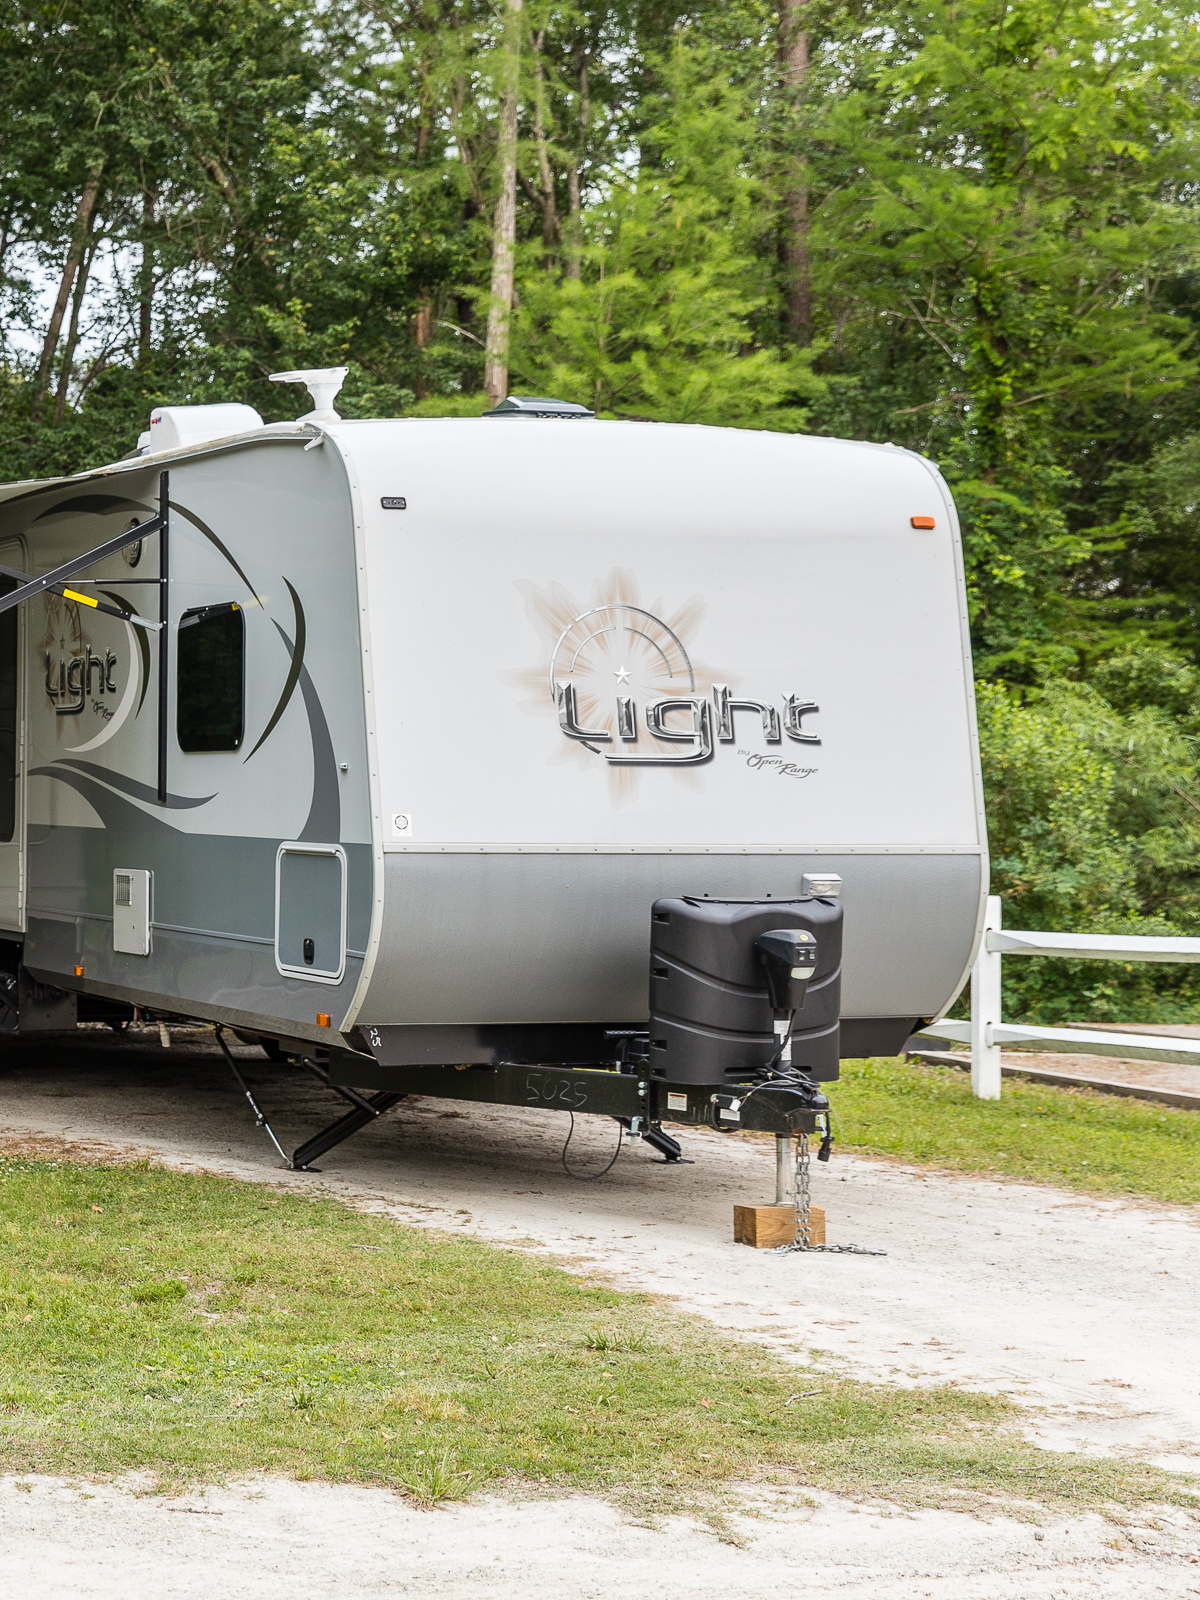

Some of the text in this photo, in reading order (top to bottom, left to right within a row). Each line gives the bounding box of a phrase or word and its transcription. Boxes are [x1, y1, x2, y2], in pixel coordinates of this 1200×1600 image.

[555, 681, 822, 766] Light
[746, 754, 784, 770] Open
[774, 763, 819, 779] Range
[525, 1073, 588, 1108] 5025
